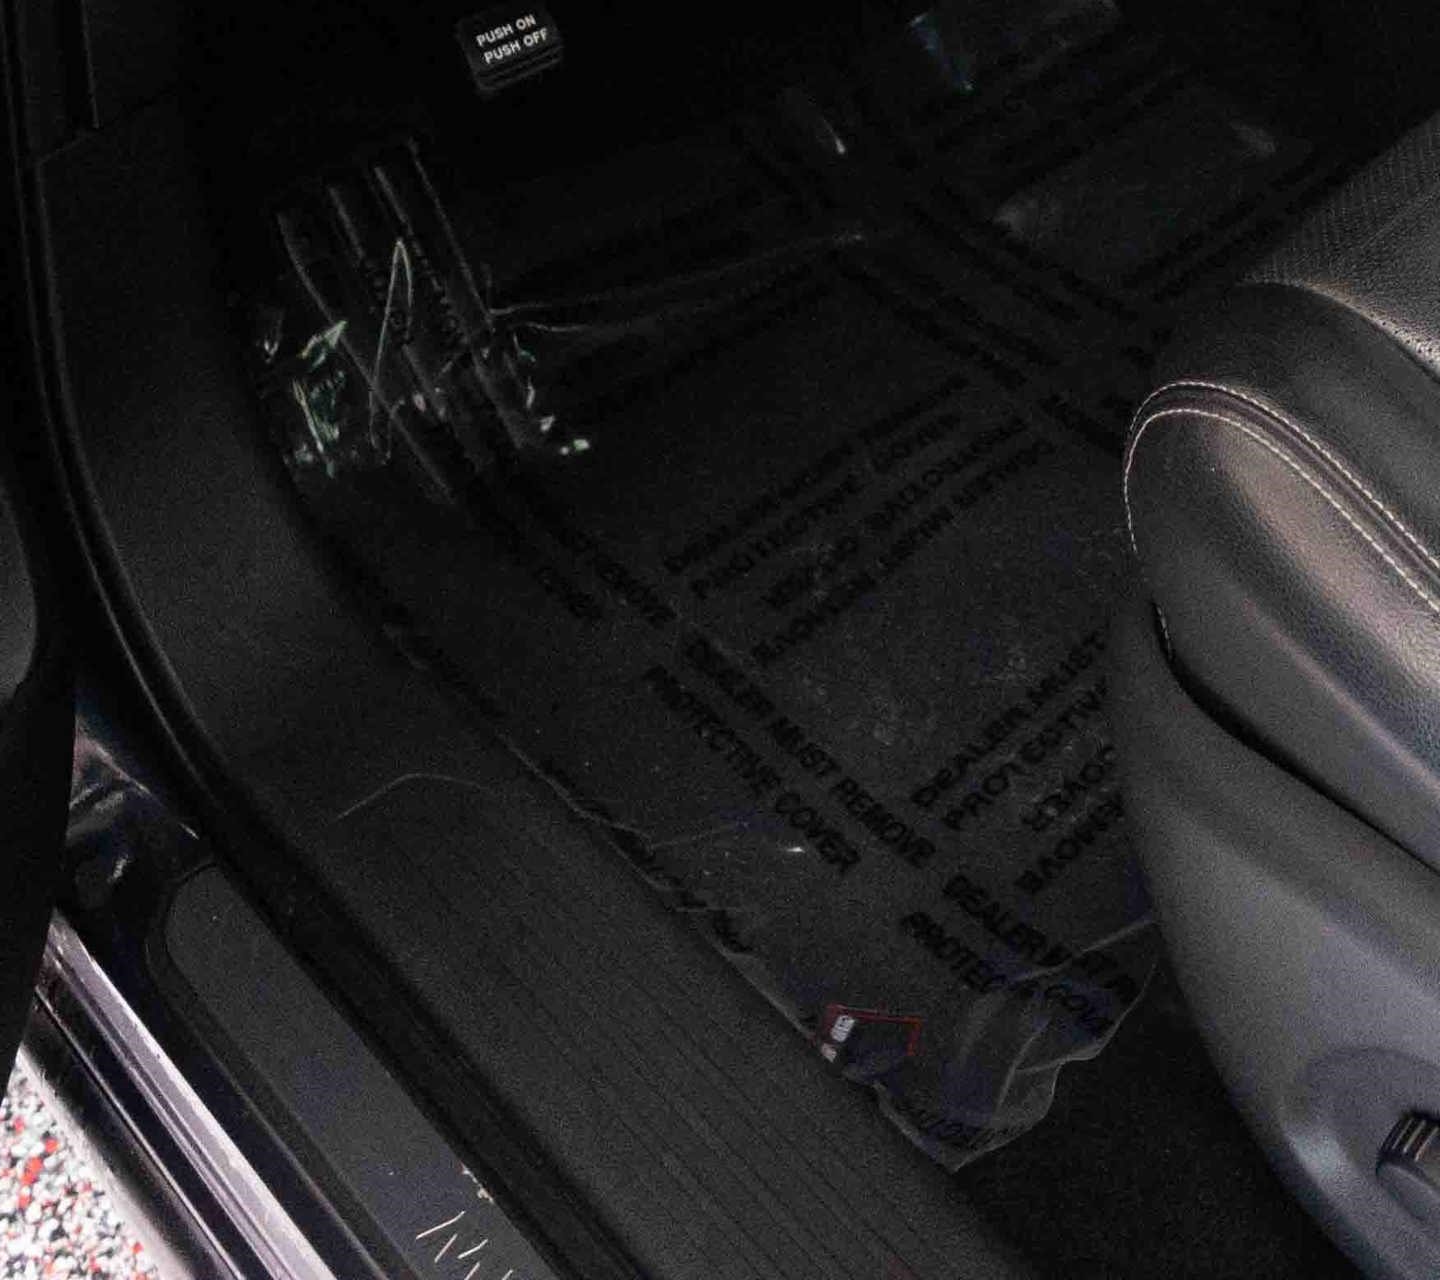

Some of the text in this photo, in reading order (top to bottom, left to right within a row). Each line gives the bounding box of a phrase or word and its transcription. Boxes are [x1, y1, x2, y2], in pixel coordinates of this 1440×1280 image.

[476, 14, 536, 47] PUSH ON
[484, 27, 547, 64] PUSH OFF
[909, 629, 1110, 813] DEALER MUST
[764, 712, 843, 784] MUST
[828, 773, 938, 871] REMOVE
[771, 786, 862, 876] COVER
[942, 871, 1049, 961] DEALER
